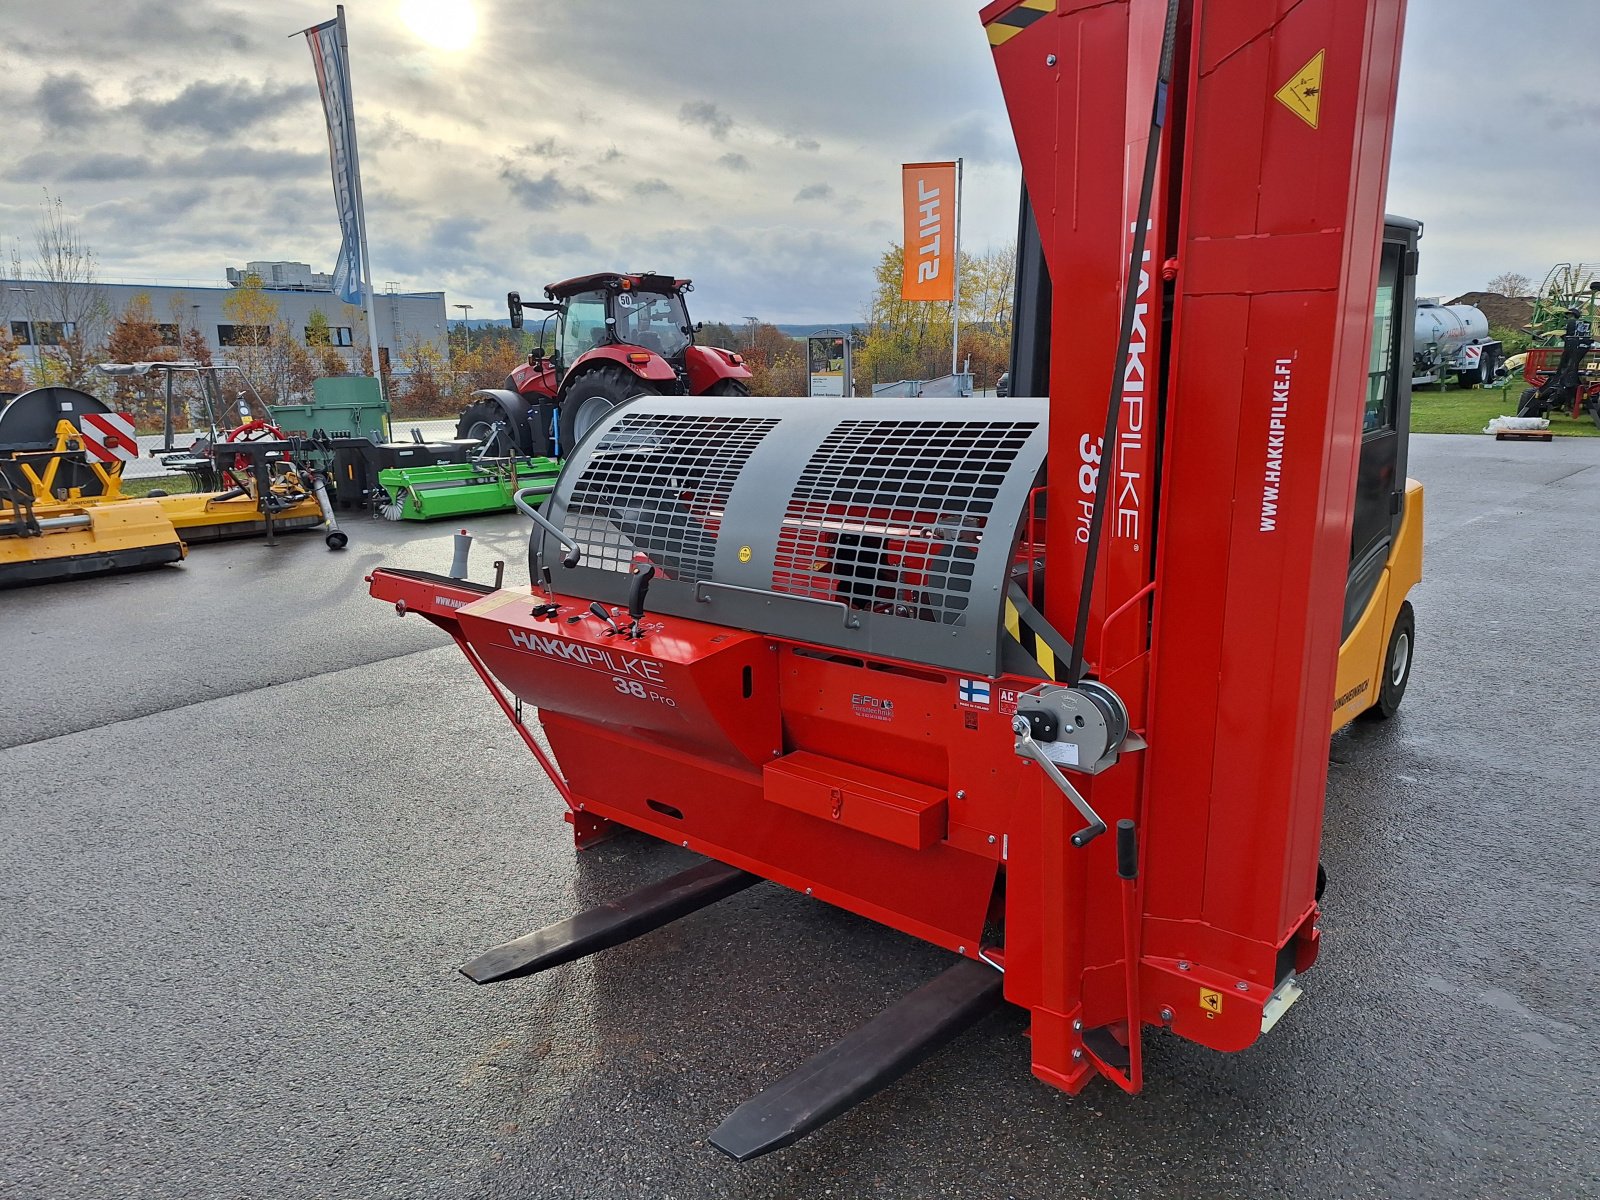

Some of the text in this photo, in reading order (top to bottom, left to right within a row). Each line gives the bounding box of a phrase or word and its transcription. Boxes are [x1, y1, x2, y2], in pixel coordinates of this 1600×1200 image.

[620, 296, 630, 305] 50
[1259, 357, 1293, 532] WWW.HAKKIPILKE.FI
[1074, 432, 1105, 545] 38 Pro
[508, 628, 664, 684] HAKKIPILKE
[612, 676, 676, 708] 38 Pro
